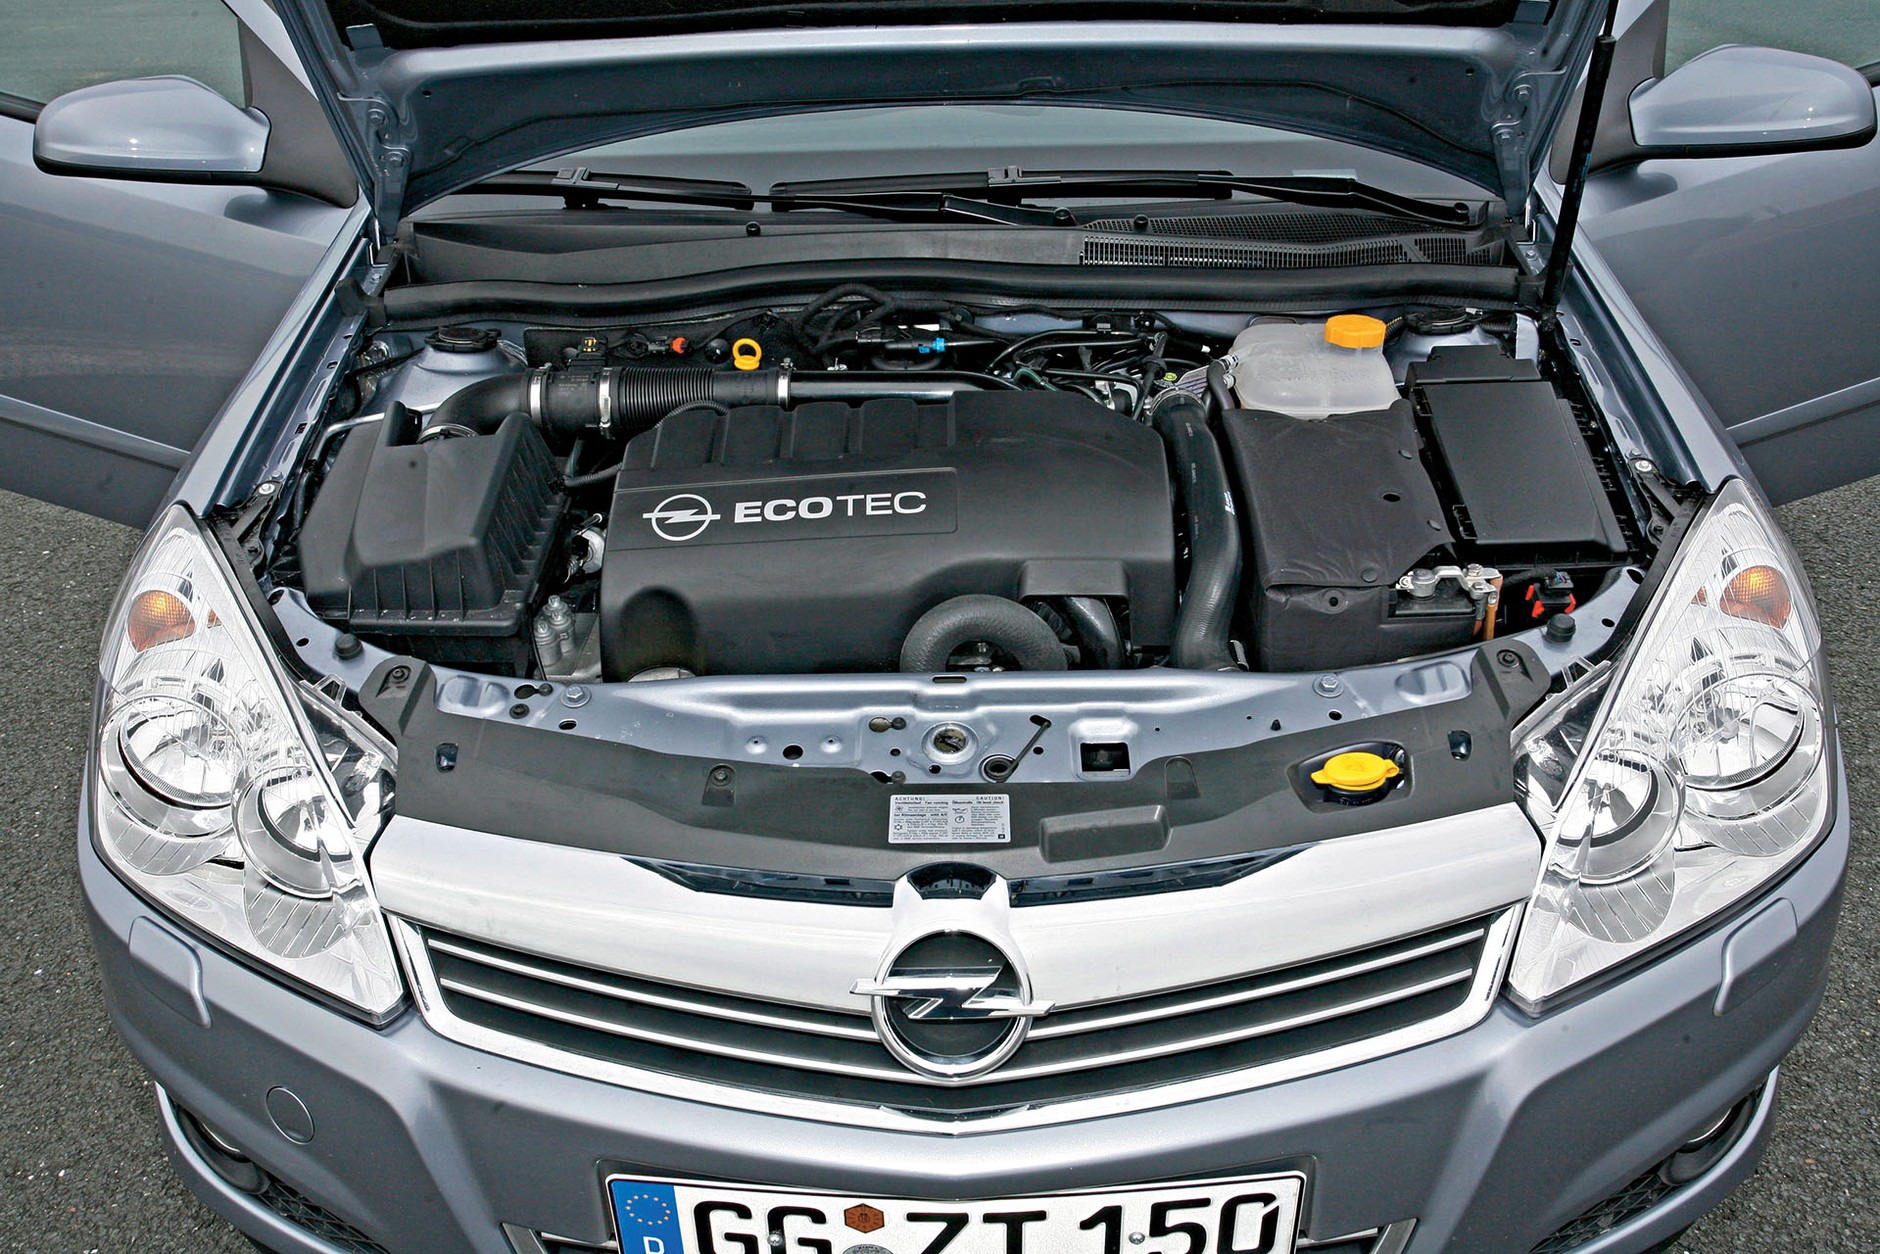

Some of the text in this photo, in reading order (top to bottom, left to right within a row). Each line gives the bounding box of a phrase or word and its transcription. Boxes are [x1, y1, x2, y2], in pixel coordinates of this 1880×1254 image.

[734, 491, 927, 523] ECOTEC
[694, 1192, 1281, 1254] GG ZT 150
[643, 1236, 665, 1254] D
